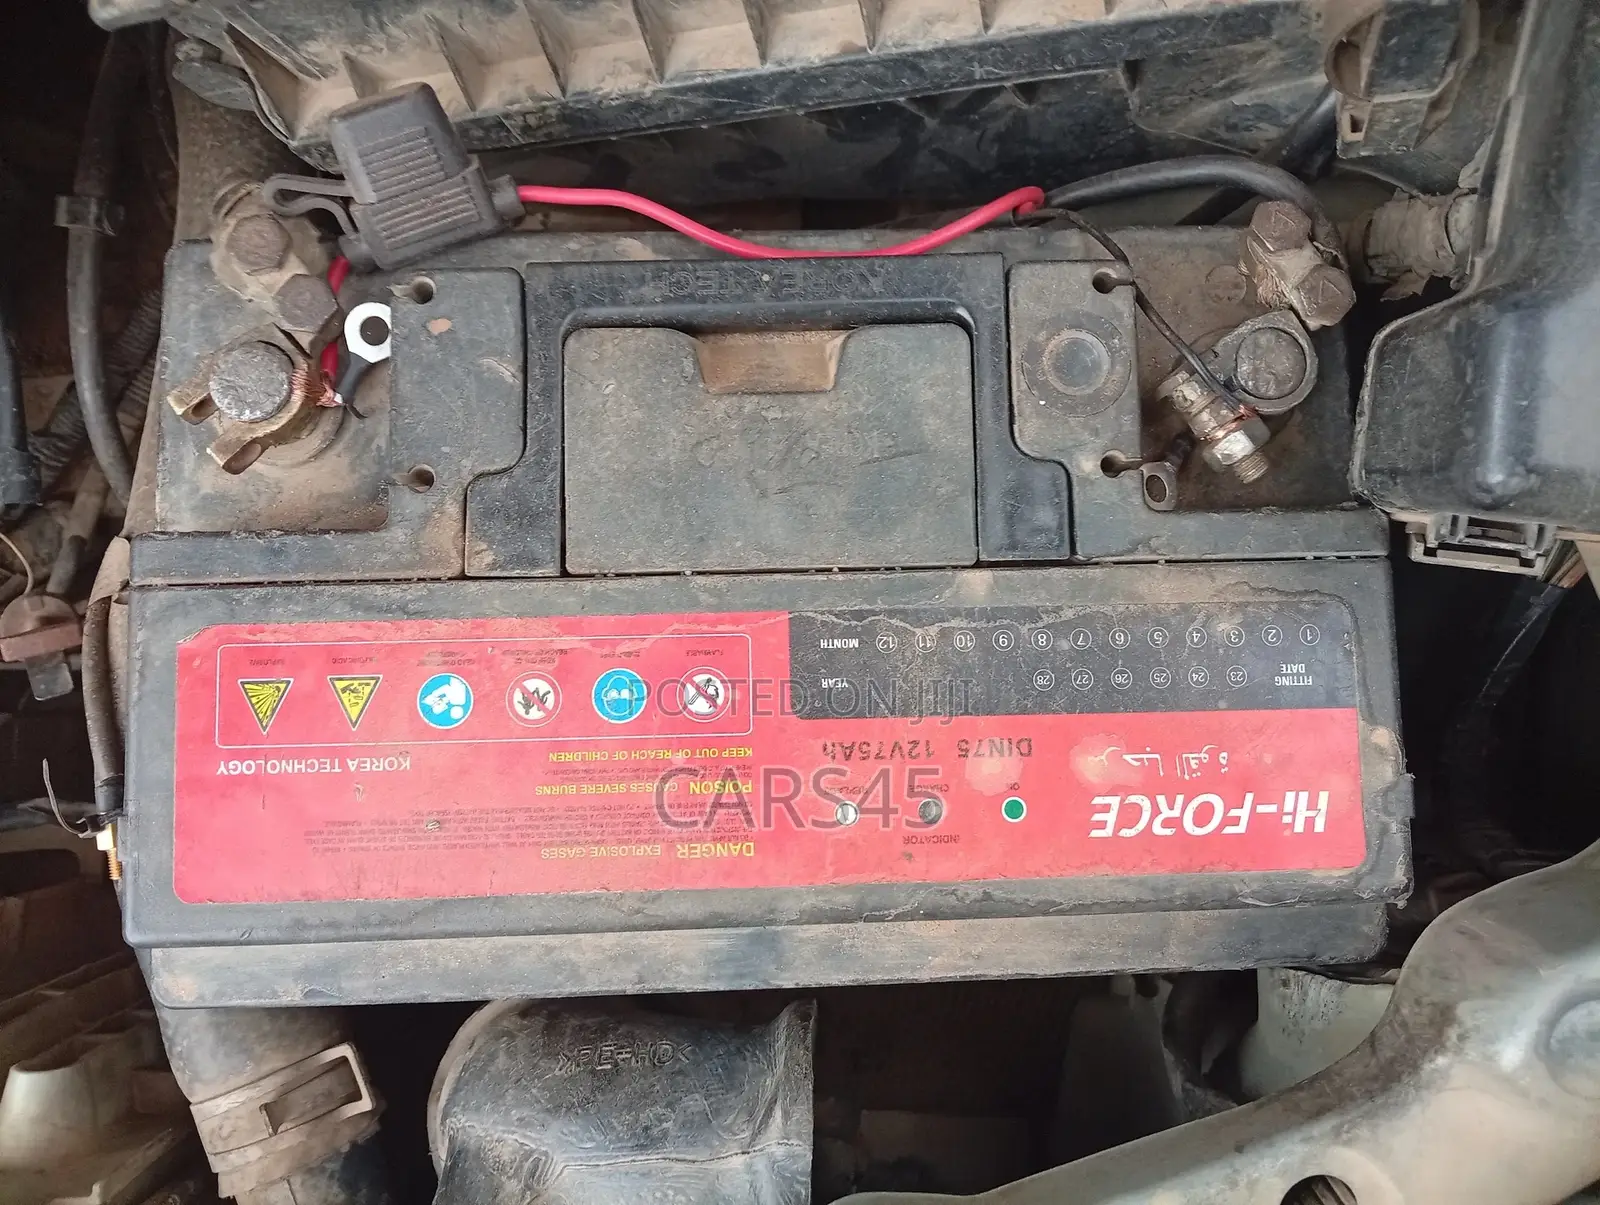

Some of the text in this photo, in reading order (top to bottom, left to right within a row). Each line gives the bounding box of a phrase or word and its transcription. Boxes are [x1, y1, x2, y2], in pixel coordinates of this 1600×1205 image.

[820, 638, 858, 648] MONTH
[1280, 664, 1306, 674] DATE
[822, 678, 848, 688] YEAR
[1274, 676, 1312, 686] FITTING
[548, 747, 752, 762] KEEP OUT OF REACH OF CHILDREN
[822, 738, 1032, 762] DIN75 12V75Ah
[216, 756, 410, 776] KOREA TECHNOLOGY
[1176, 744, 1228, 780] القوة
[535, 780, 752, 795] POISON CAUSES SEVERE BURNS
[1088, 790, 1329, 838] Hi-FORCE
[902, 834, 960, 844] INDICATOR
[540, 842, 754, 859] DANGER EXPLOSIVE GASES
